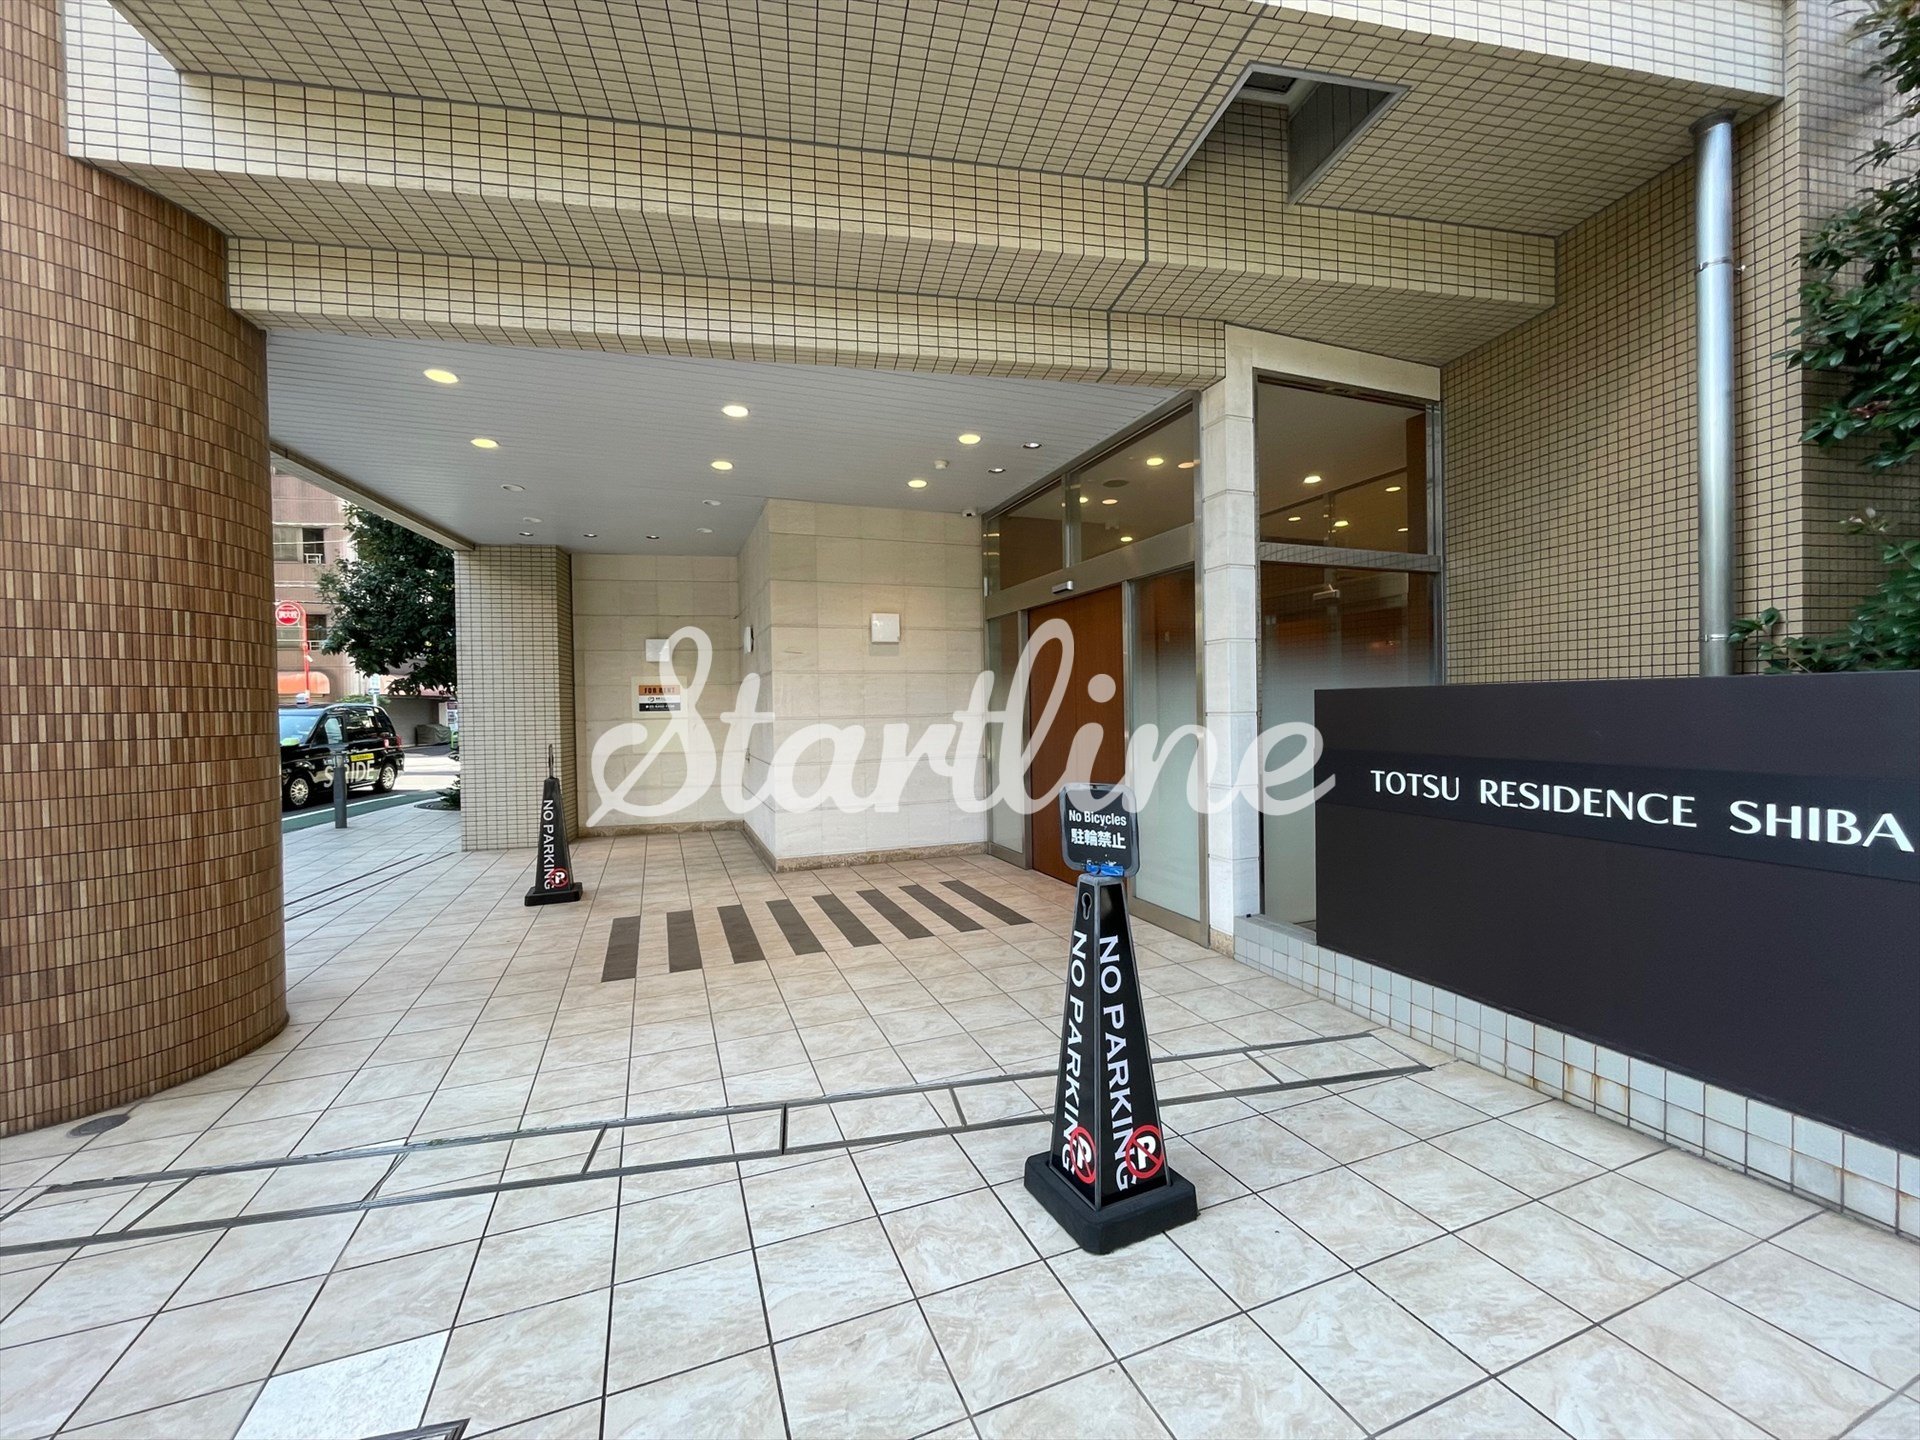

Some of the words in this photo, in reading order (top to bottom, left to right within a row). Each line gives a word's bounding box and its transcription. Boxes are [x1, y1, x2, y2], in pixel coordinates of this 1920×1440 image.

[543, 799, 554, 821] NO
[1068, 809, 1082, 822] No
[1084, 811, 1127, 827] Bicycles
[1071, 828, 1126, 849] 駐輪禁止
[1370, 769, 1460, 801] TOTSU
[1480, 779, 1697, 828] RESIDENCE
[1729, 800, 1915, 853] SHIBA
[543, 824, 555, 890] PARKING
[1070, 929, 1087, 988] NO
[1099, 935, 1122, 995] NO
[1060, 994, 1084, 1175] PARKING
[1103, 1003, 1138, 1192] PARKING
